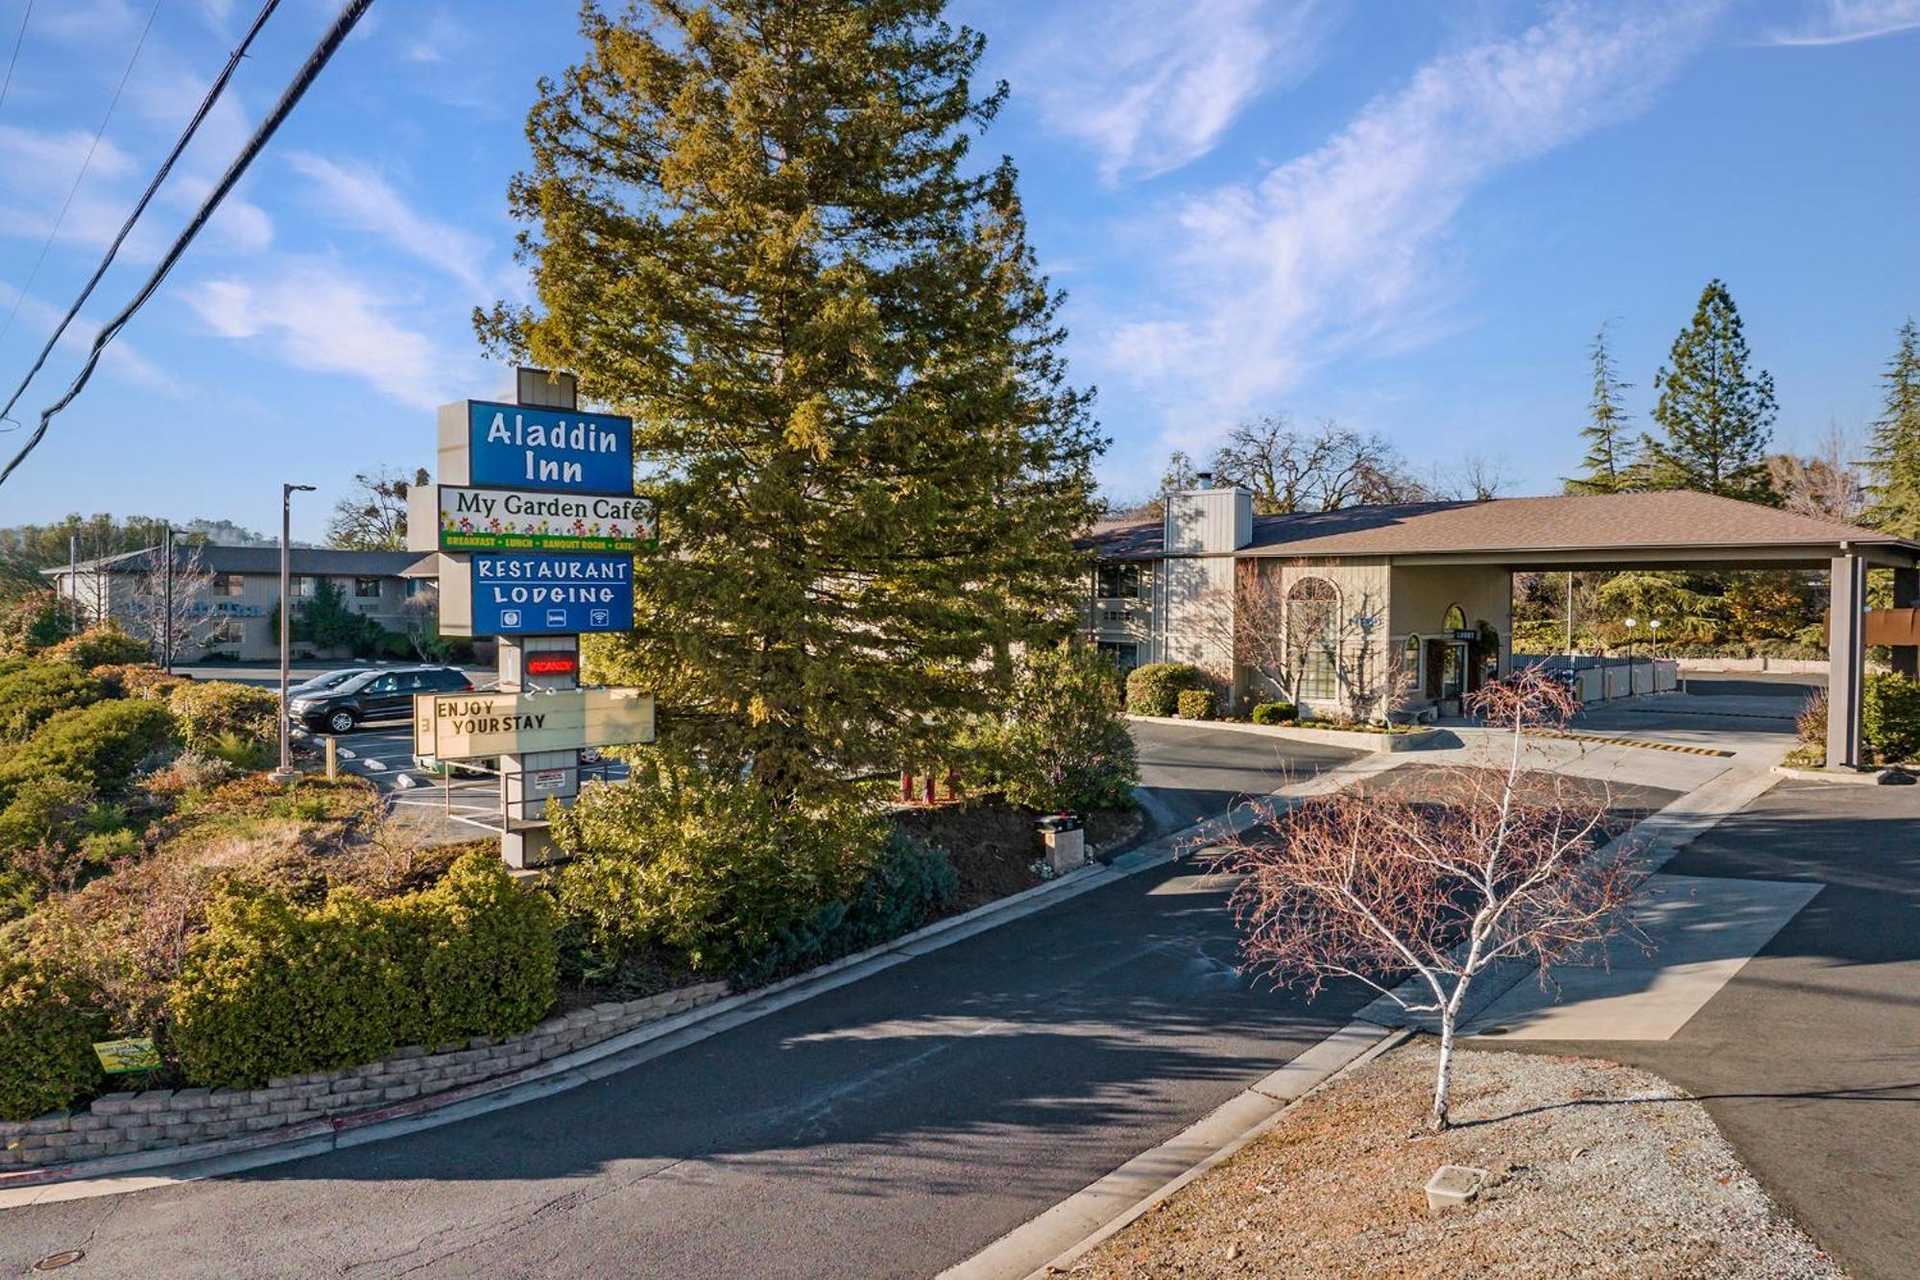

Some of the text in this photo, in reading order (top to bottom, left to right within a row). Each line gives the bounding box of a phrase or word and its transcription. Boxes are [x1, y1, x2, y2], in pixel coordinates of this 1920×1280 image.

[486, 412, 618, 453] Aladdin
[525, 450, 583, 484] Inn
[456, 492, 497, 519] My
[504, 494, 588, 518] Garden
[446, 536, 495, 547] BREAKFAST
[505, 538, 533, 548] LUNCH
[478, 559, 628, 579] RESTAURANT
[493, 586, 616, 603] LODGING
[438, 700, 494, 718] ENJOY
